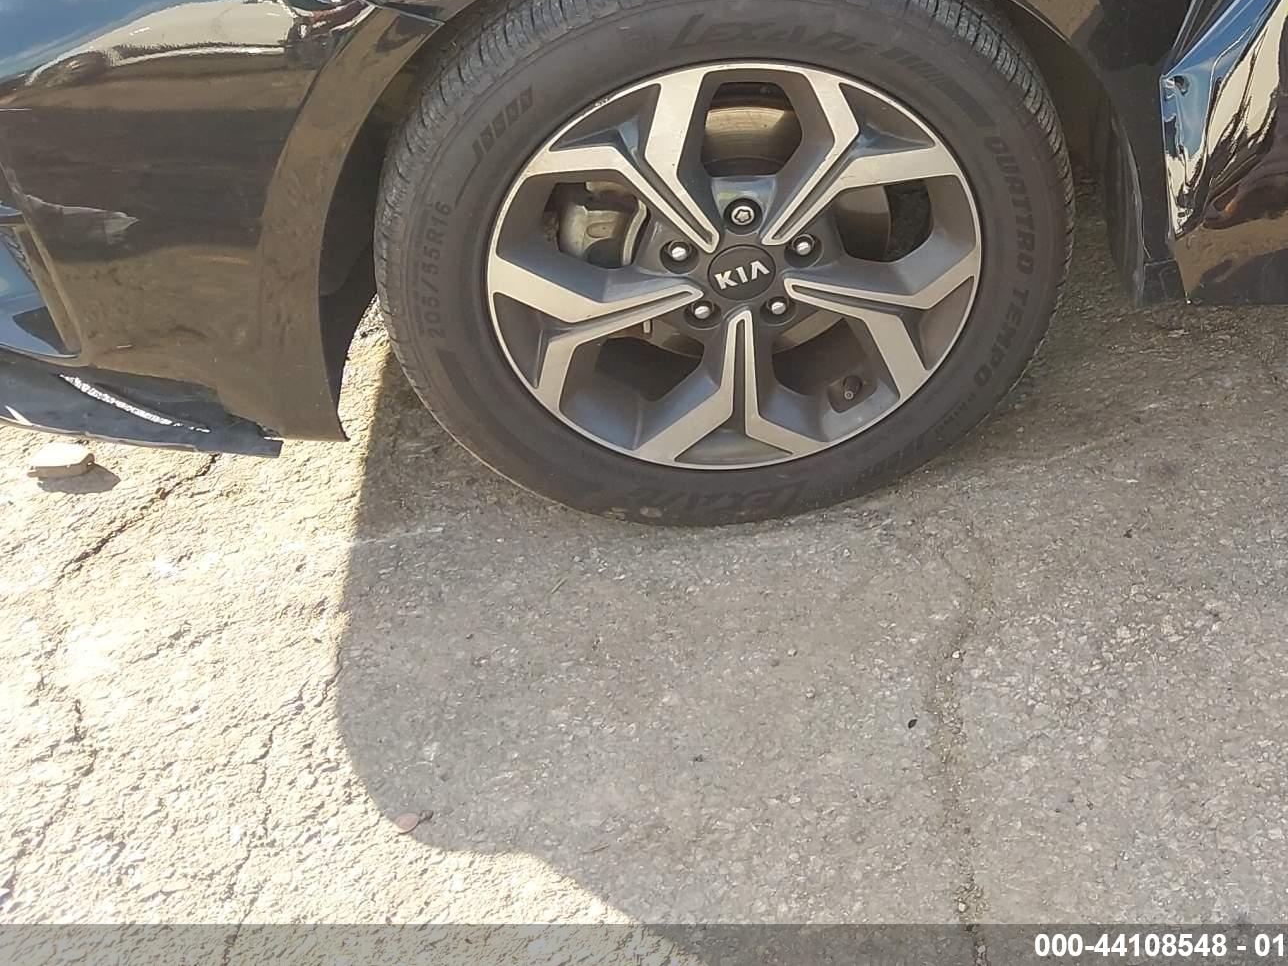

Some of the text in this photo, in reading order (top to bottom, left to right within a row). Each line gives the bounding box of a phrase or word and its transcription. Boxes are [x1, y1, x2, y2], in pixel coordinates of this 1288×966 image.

[419, 200, 452, 340] 205/55R16
[714, 260, 770, 290] KIA
[973, 136, 1036, 387] QUATTRO TEMPO
